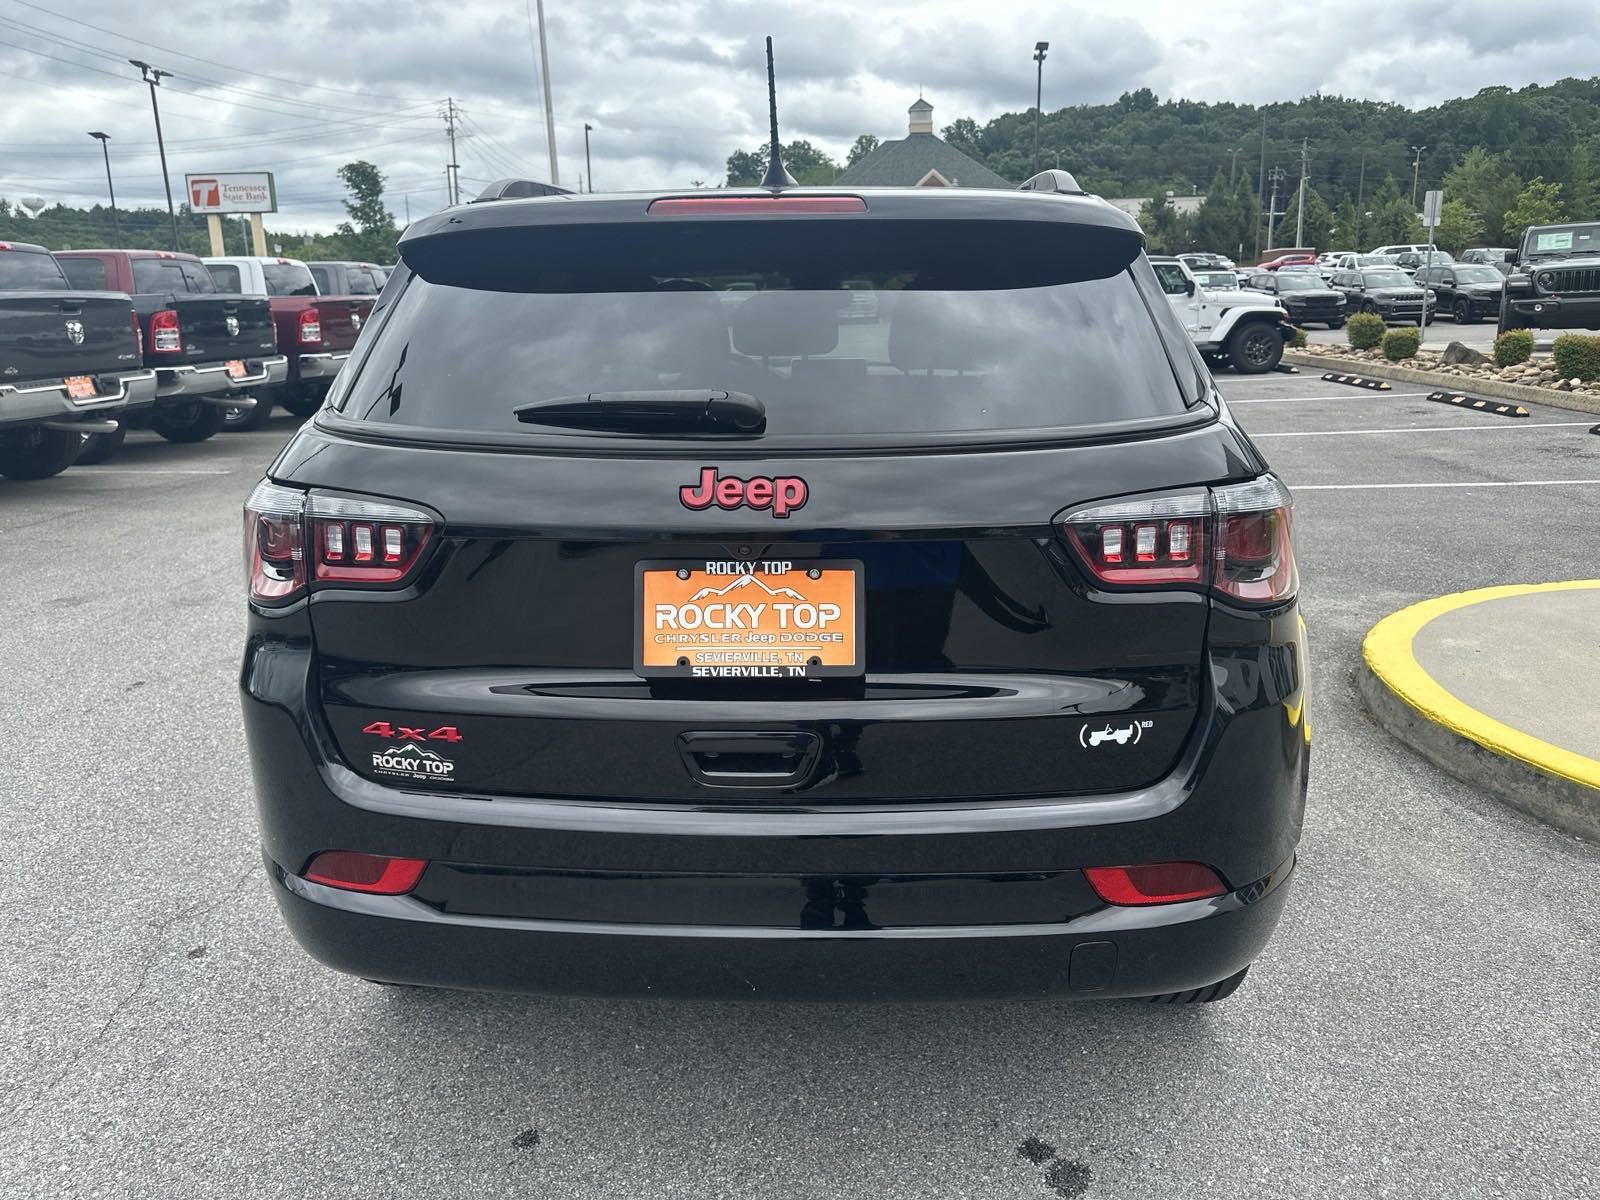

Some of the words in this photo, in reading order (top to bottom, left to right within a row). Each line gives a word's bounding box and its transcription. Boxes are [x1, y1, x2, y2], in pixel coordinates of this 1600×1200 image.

[222, 184, 268, 192] Tennessee
[245, 192, 268, 200] Bank
[680, 467, 809, 518] Jeep
[706, 561, 756, 575] ROCKY
[762, 561, 792, 575] TOP
[655, 603, 768, 629] ROCKY
[773, 603, 841, 629] TOP
[654, 633, 742, 643] CHRYSLER
[745, 632, 776, 643] Jeep
[780, 633, 844, 642] DODGE
[696, 653, 782, 664] SEVIERVILLE,
[786, 652, 804, 663] TN
[692, 667, 783, 677] SEVIERVILLE,
[788, 667, 806, 676] TN
[1141, 720, 1153, 728] RED
[372, 754, 421, 770] ROCKY
[422, 760, 454, 774] TOP
